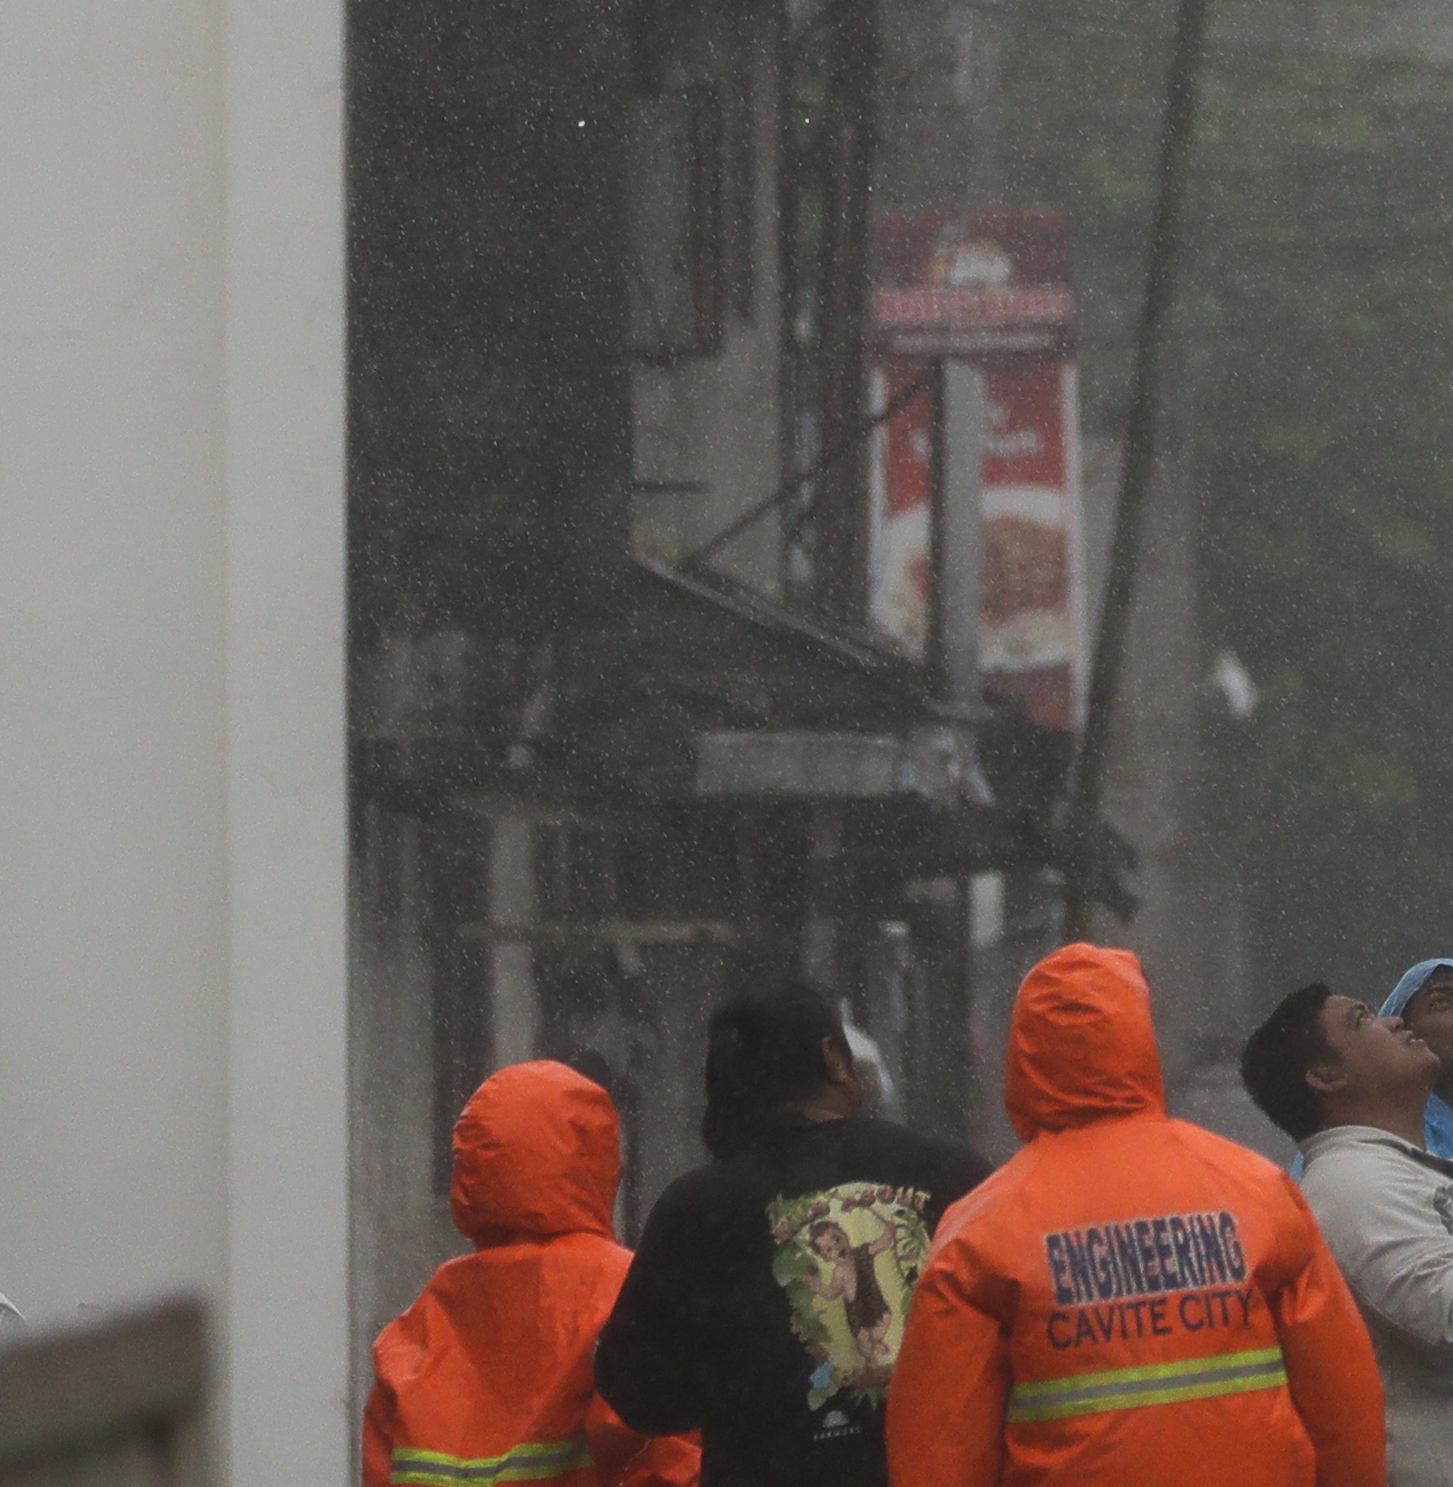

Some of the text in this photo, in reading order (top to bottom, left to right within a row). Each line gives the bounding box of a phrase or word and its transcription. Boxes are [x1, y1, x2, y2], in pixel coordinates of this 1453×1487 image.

[1044, 1211, 1249, 1307] ENGINEERING
[1046, 1287, 1254, 1351] CAVITE CITY
